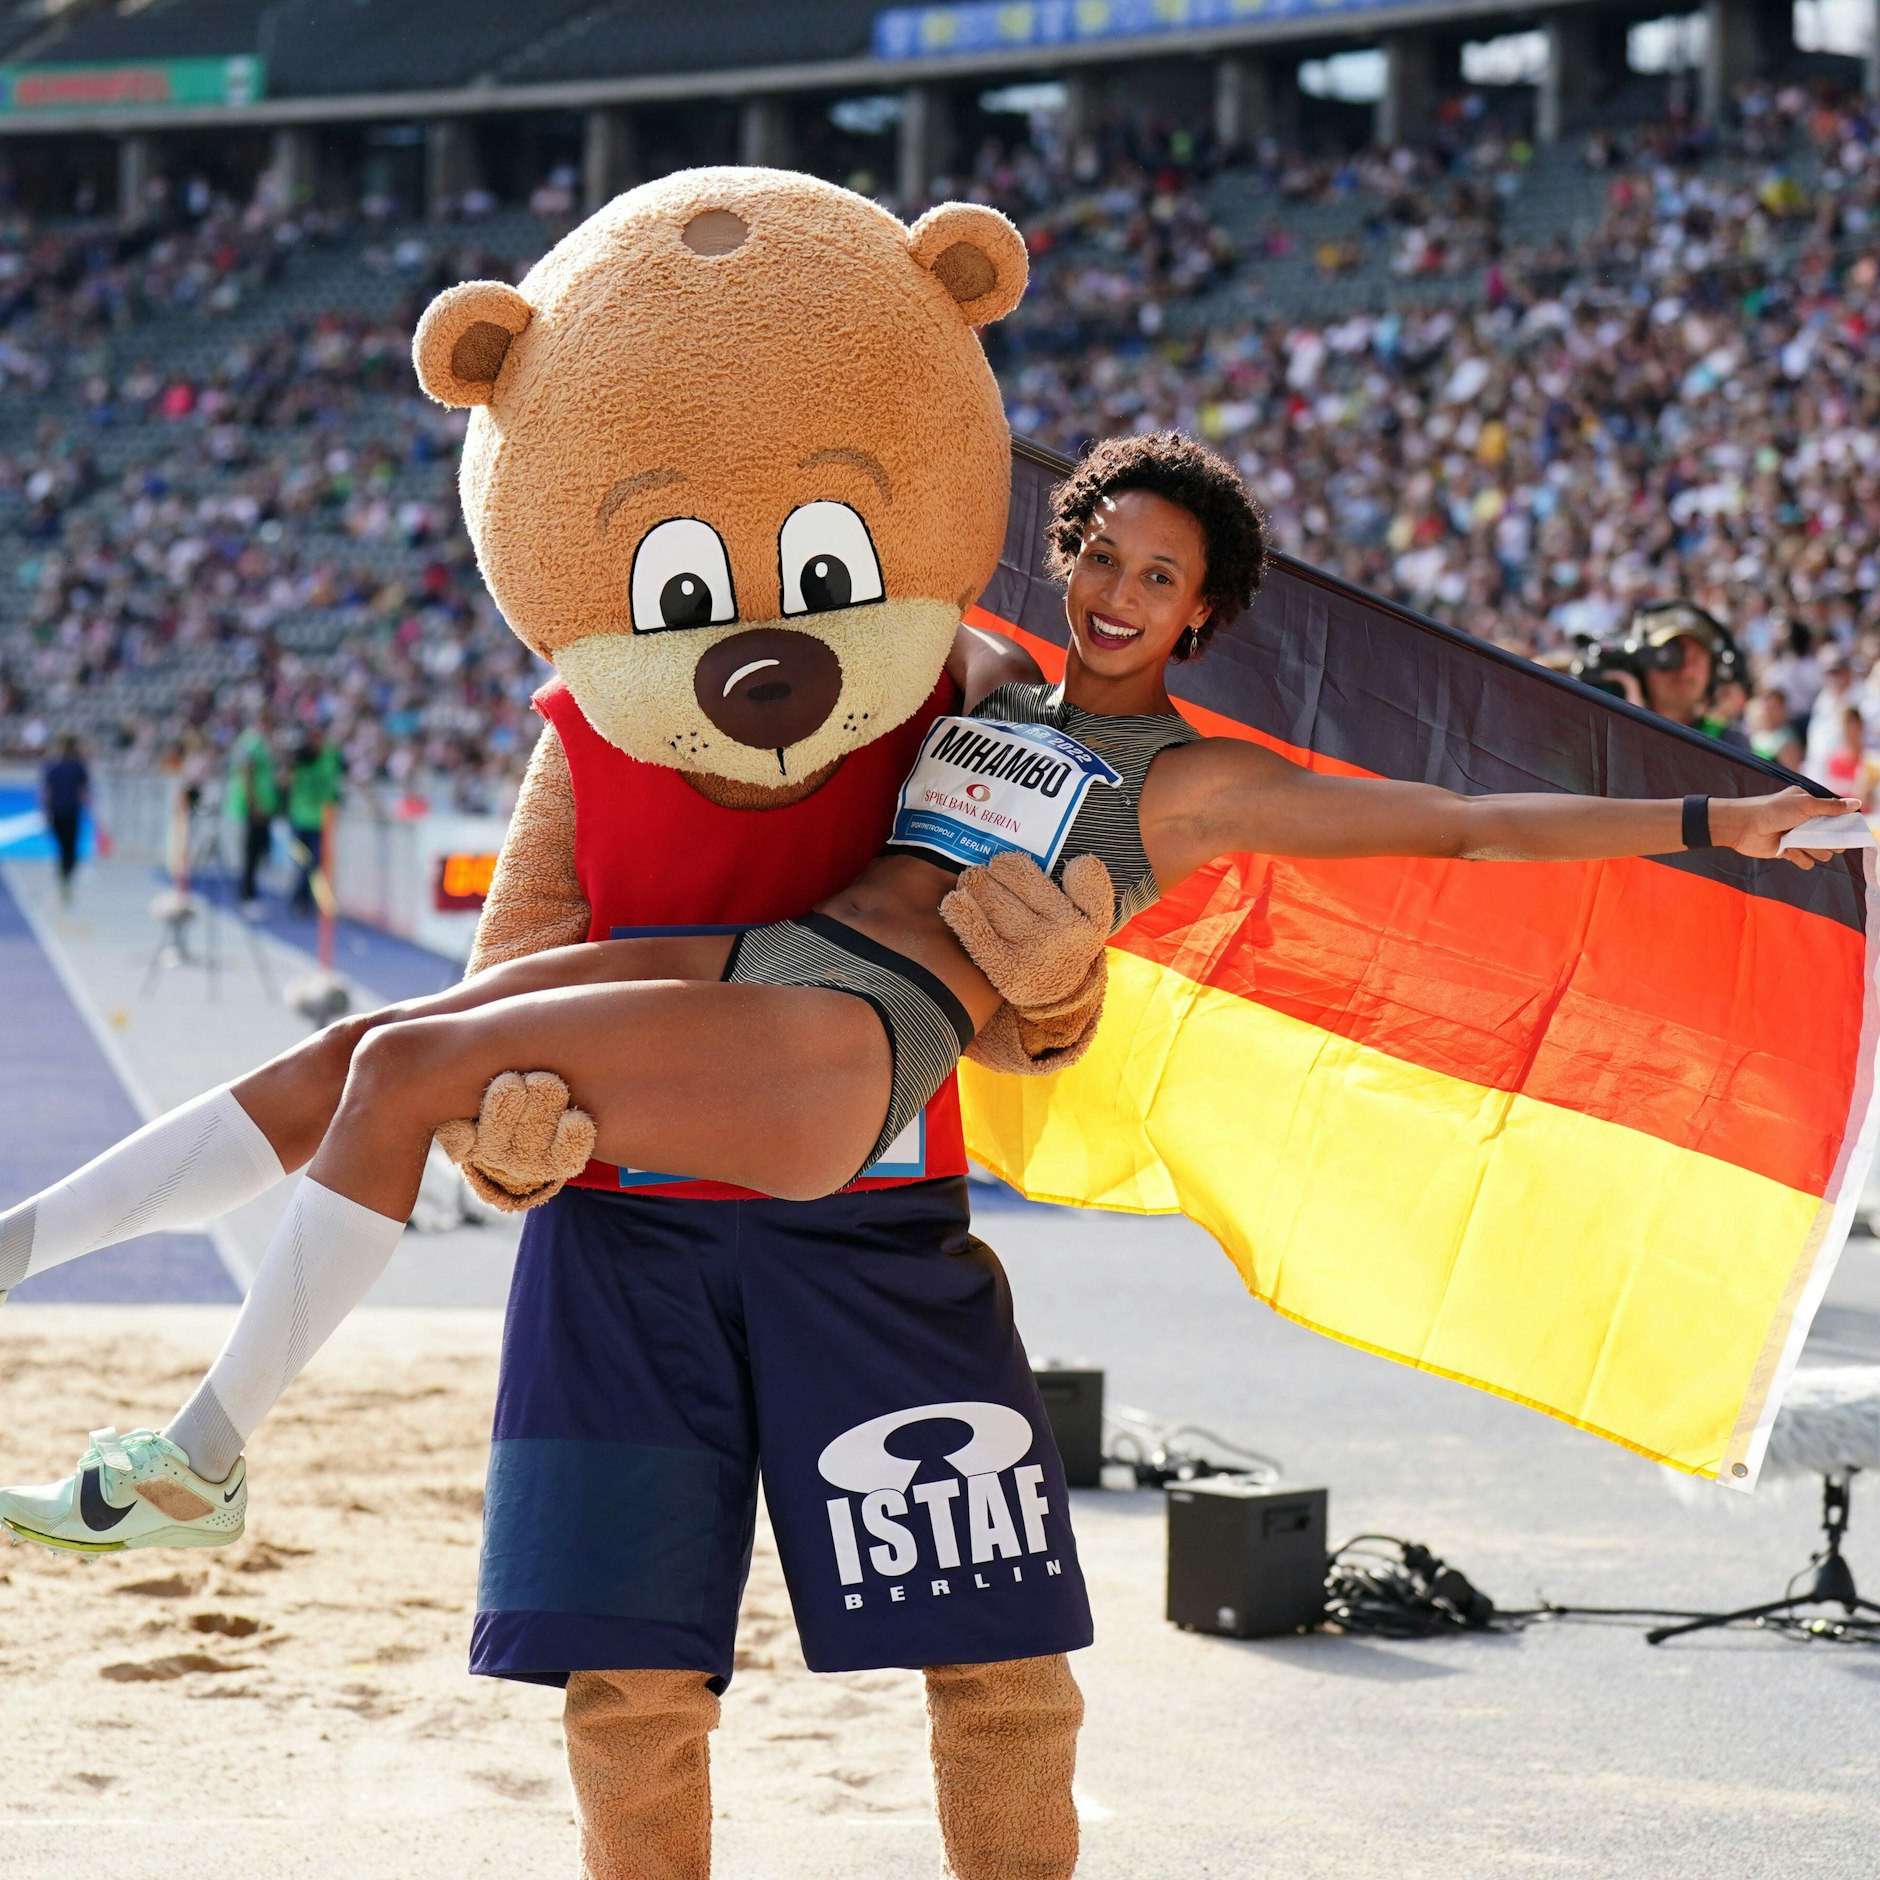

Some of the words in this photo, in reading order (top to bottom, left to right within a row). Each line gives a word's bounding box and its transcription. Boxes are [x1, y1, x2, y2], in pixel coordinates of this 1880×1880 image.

[930, 725, 1073, 799] MIHAMBO
[1048, 737, 1093, 764] 2022
[924, 789, 980, 818] SPIELBANK
[980, 809, 1022, 833] BERLIN
[960, 836, 992, 855] BERLIN
[826, 1463, 1050, 1586] ISTAF
[843, 1559, 1063, 1611] BERLIN
